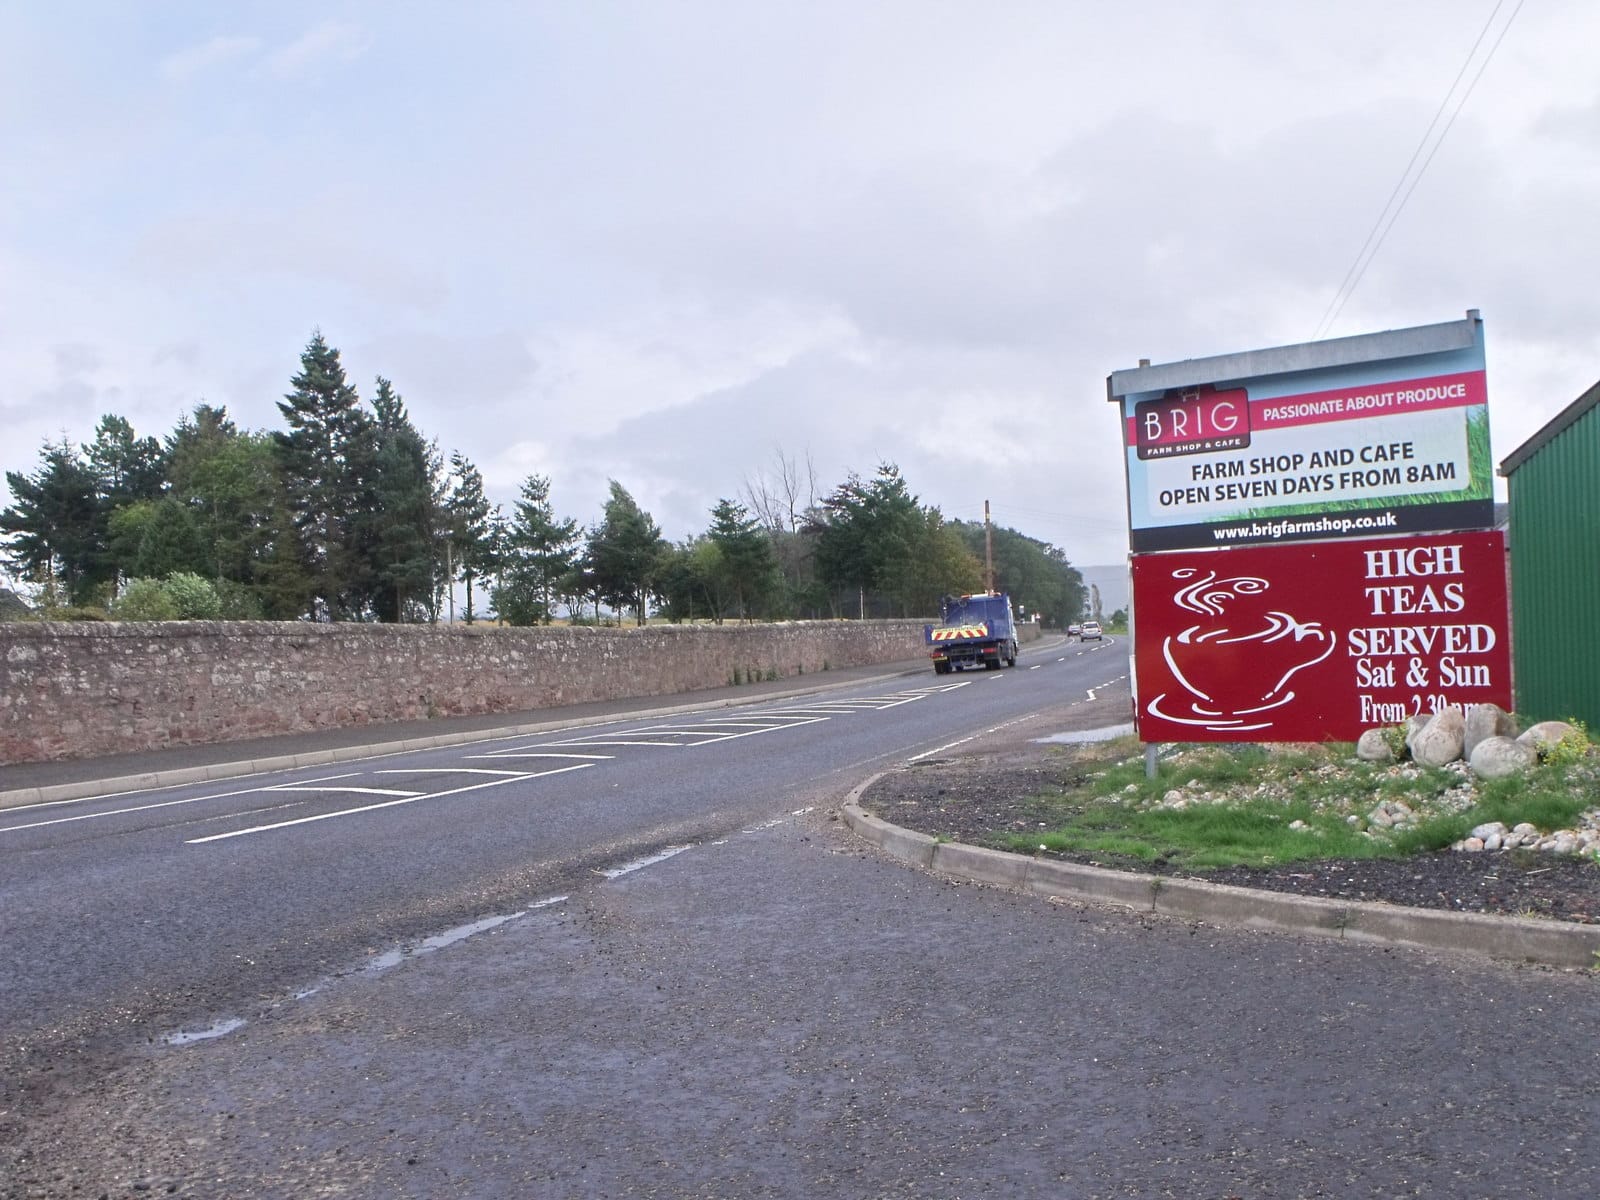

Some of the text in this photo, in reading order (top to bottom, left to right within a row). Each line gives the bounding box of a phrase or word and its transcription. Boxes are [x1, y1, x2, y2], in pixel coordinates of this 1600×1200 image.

[1263, 383, 1466, 421] PASSIONATE ABOUT PRODUCE
[1144, 402, 1238, 440] BRIG
[1147, 446, 1173, 456] FARM
[1175, 443, 1202, 452] SHOP
[1215, 438, 1241, 448] CAFE
[1192, 441, 1415, 481] FARM SHOP AND CAFE
[1159, 462, 1456, 506] OPEN SEVEN DAYS FROM 8AM
[1213, 512, 1397, 539] www.brigfarmshop.co.uk
[1364, 545, 1464, 579] HIGH
[1365, 583, 1465, 615] TEAS
[1348, 624, 1496, 657] SERVED
[1356, 656, 1491, 688] Sat & Sun
[1359, 695, 1406, 723] From
